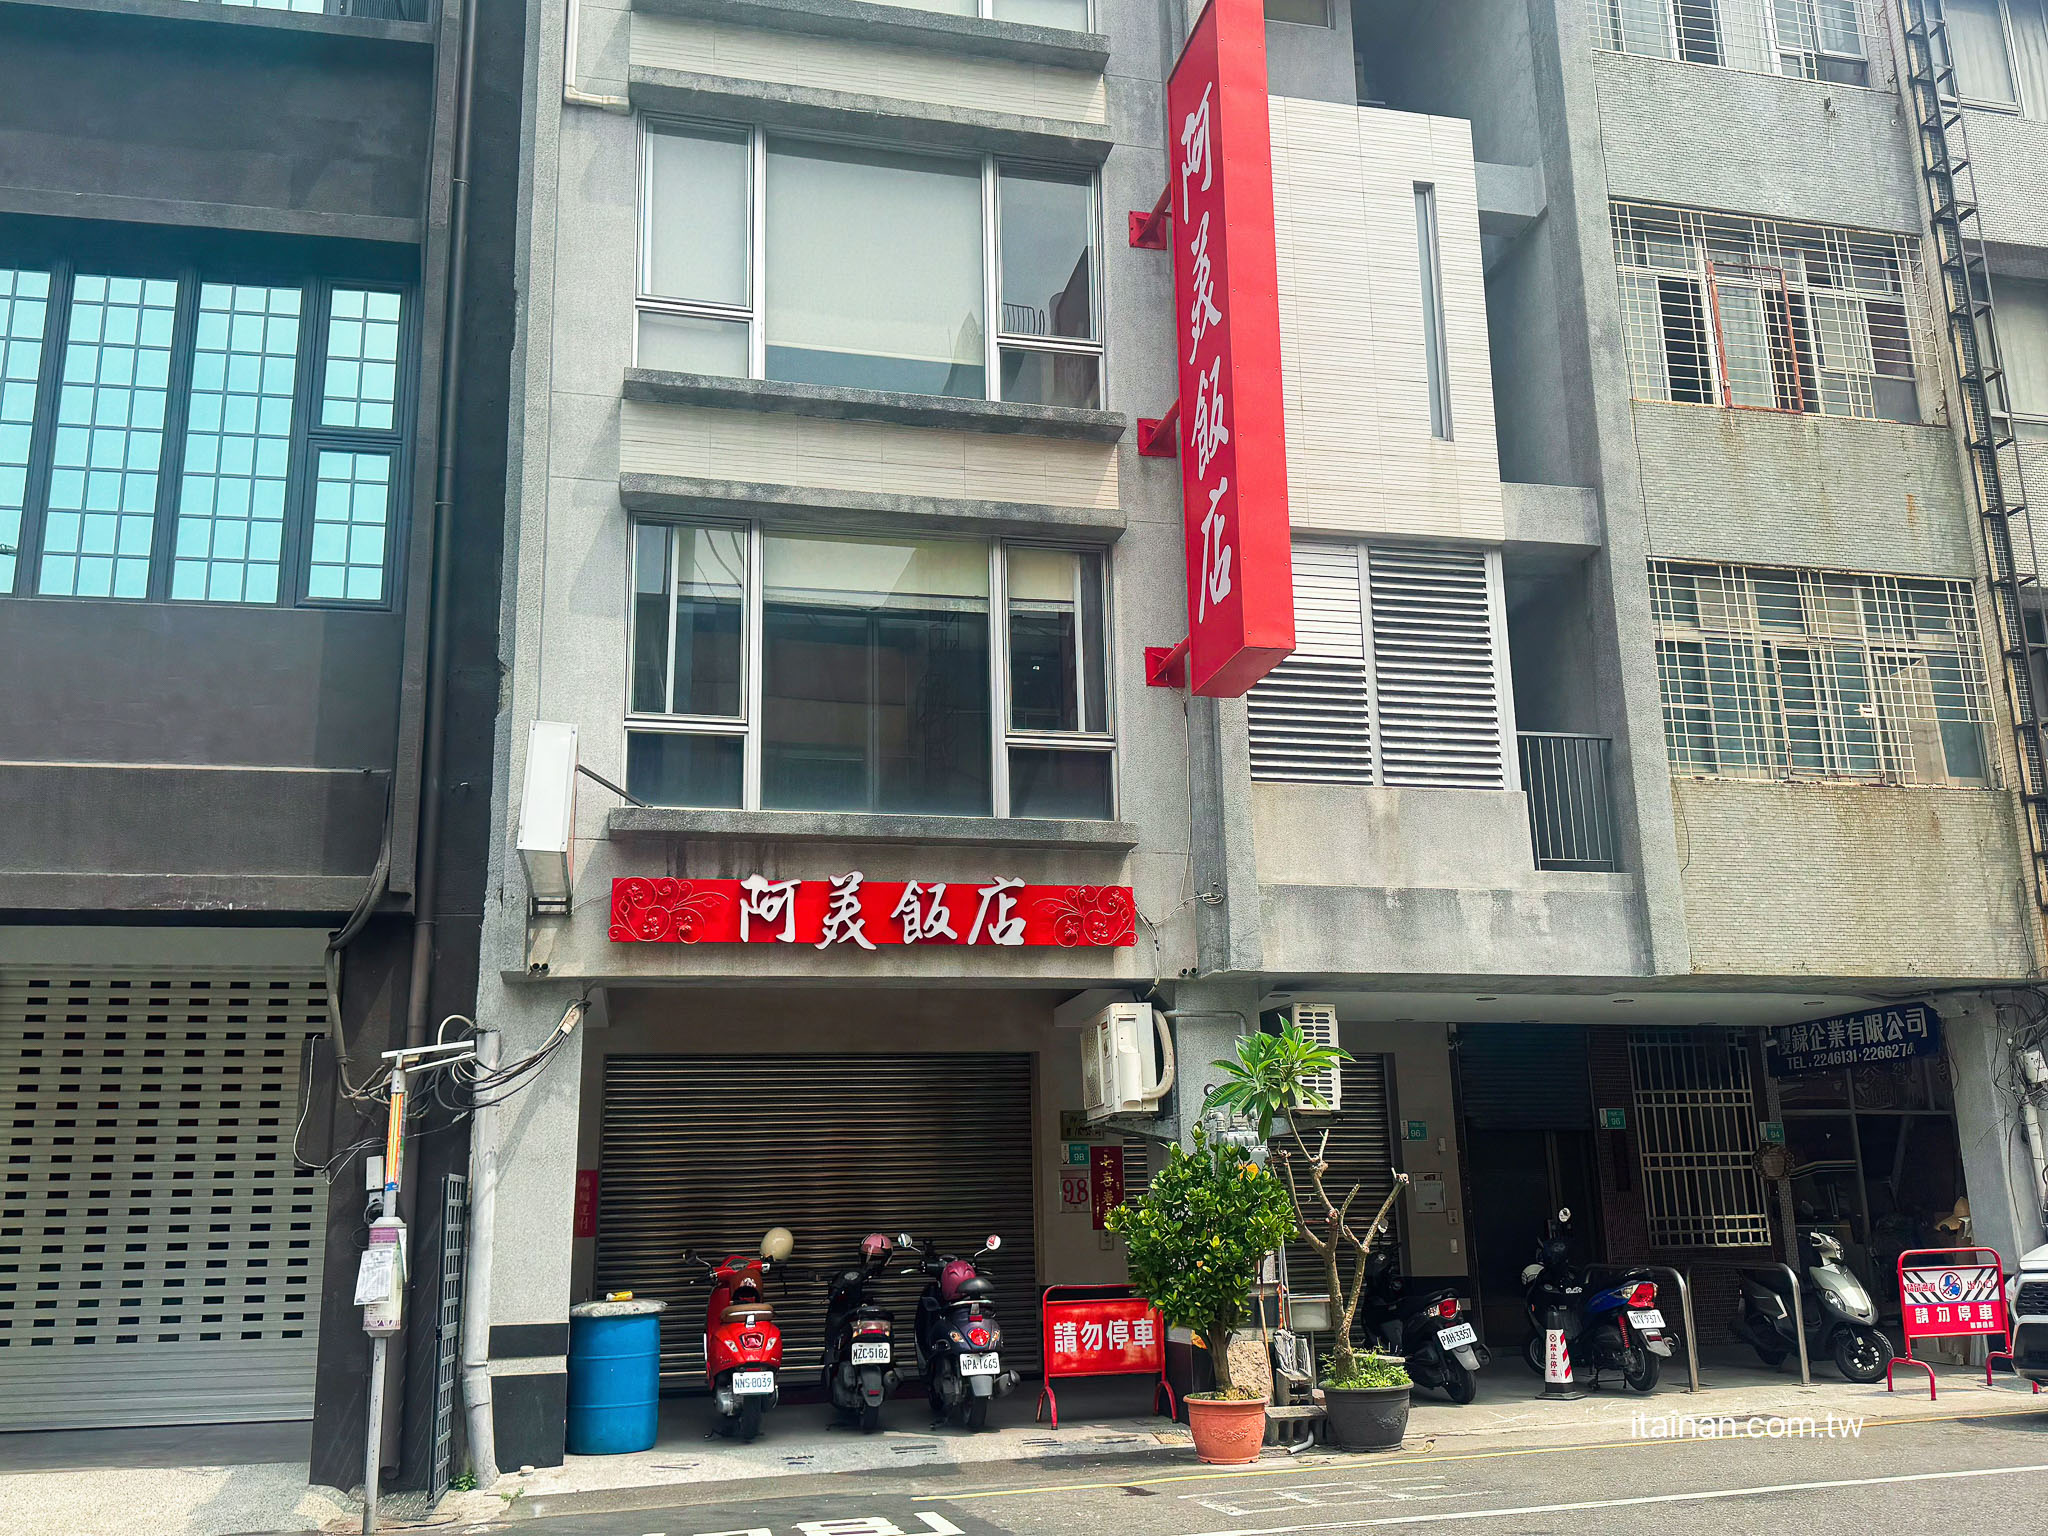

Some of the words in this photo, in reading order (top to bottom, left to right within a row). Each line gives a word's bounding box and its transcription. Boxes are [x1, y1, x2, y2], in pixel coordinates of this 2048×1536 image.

[1181, 81, 1231, 624] 阿美飯店
[740, 871, 1026, 950] 阿美飯店
[1410, 1129, 1421, 1138] 96
[1074, 1152, 1085, 1161] 98
[1062, 1179, 1089, 1203] 98
[1914, 1303, 1994, 1324] 請勿停車
[1053, 1318, 1155, 1353] 請勿停車
